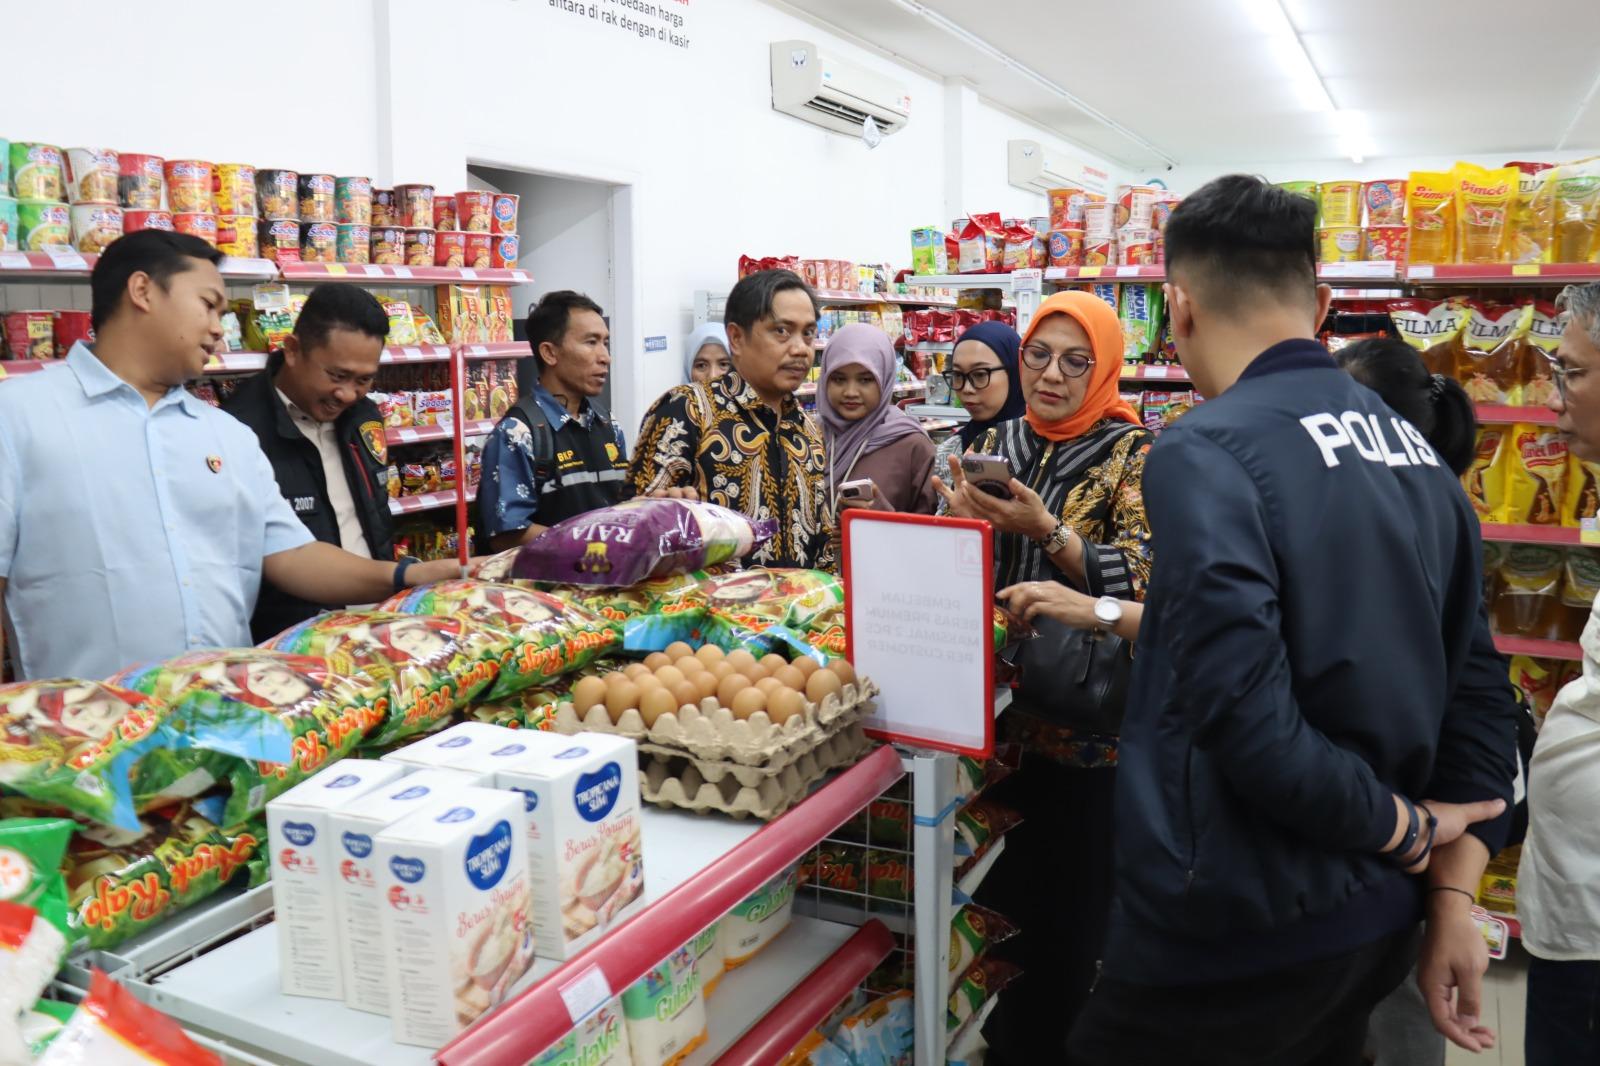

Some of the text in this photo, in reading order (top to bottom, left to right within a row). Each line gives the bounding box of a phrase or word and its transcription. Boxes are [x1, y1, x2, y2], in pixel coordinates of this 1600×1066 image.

[588, 4, 599, 19] di
[601, 10, 618, 26] rak
[620, 15, 656, 38] dengan
[658, 26, 667, 41] di
[669, 29, 690, 48] kasir
[659, 5, 683, 28] harga
[1394, 316, 1457, 334] FILMA
[557, 449, 574, 462] BKP
[294, 496, 315, 511] 2007
[572, 525, 637, 544] RAJA
[576, 776, 620, 805] TROPICANA
[589, 792, 609, 813] SLIM
[467, 835, 511, 873] TROPICANA
[481, 858, 500, 880] SLIM
